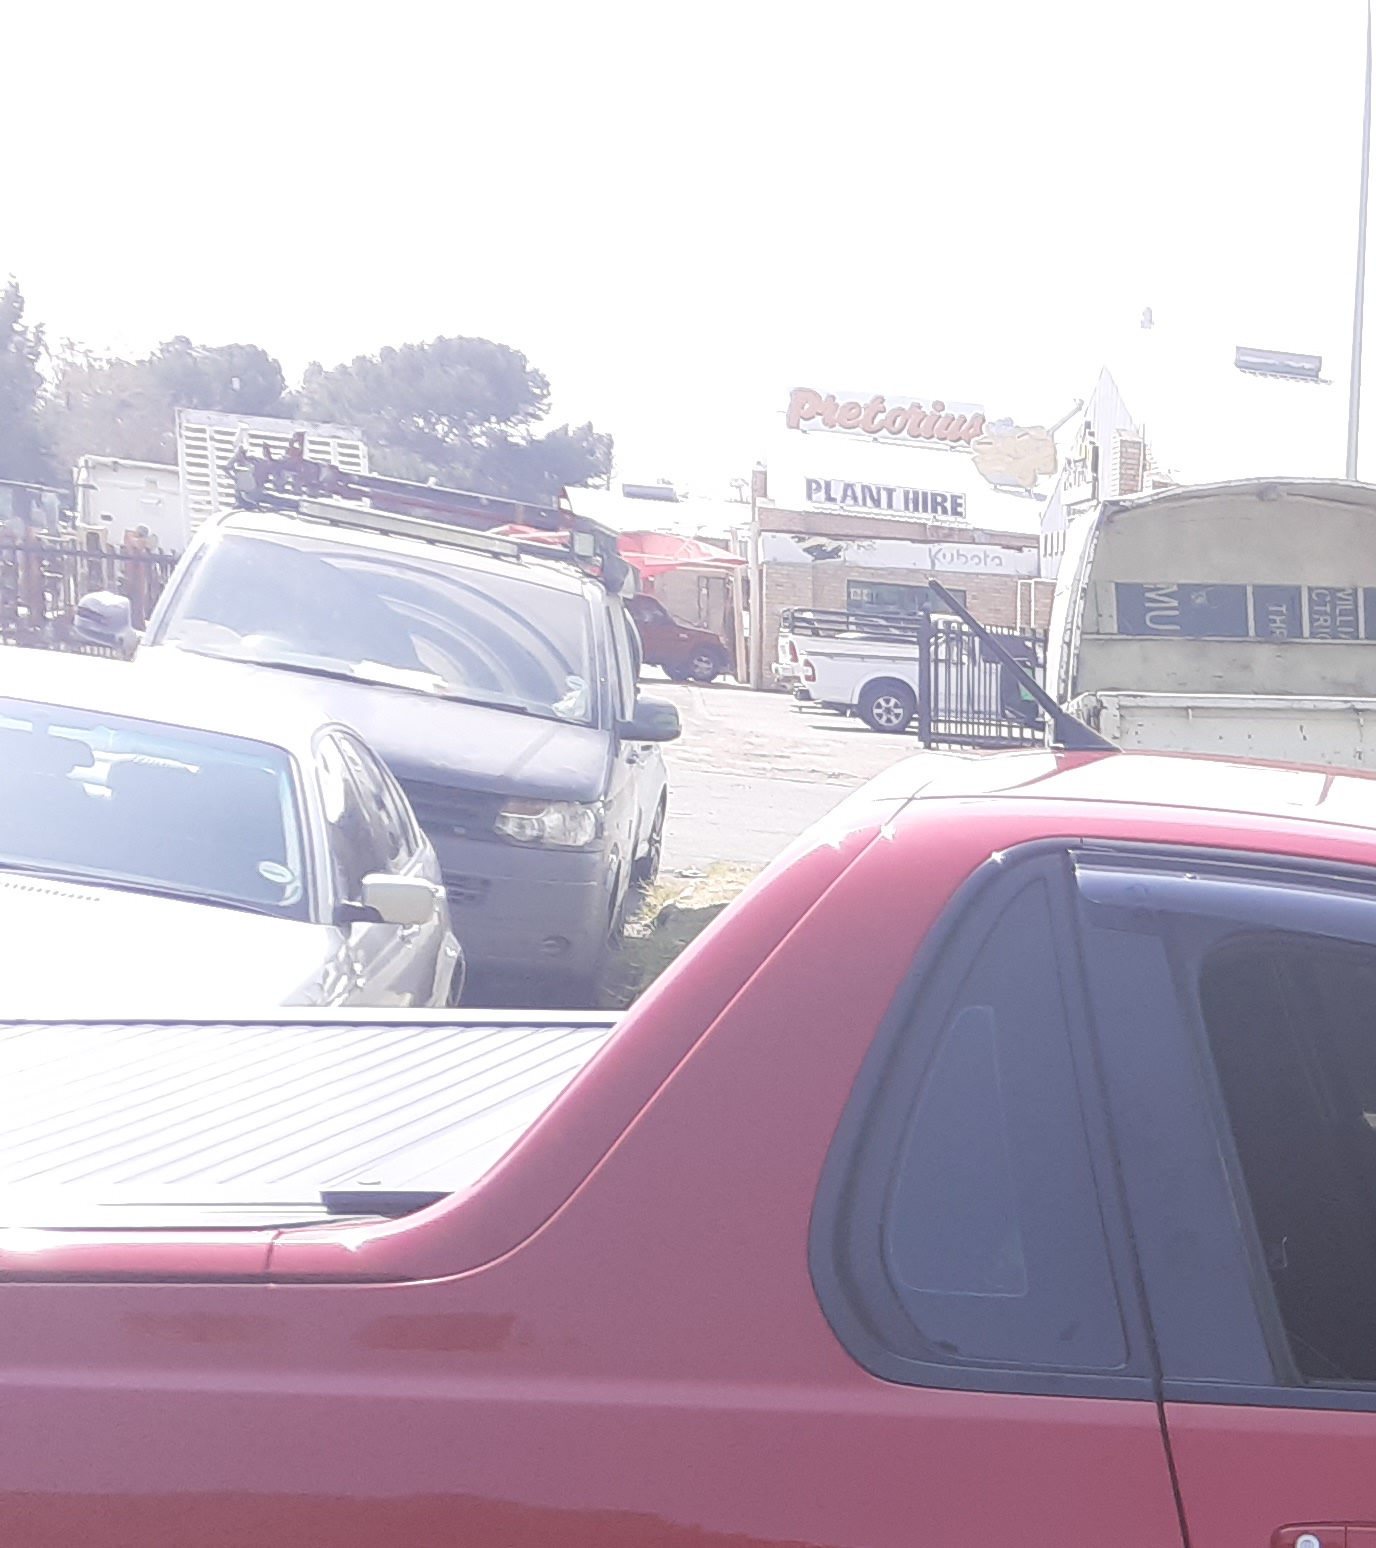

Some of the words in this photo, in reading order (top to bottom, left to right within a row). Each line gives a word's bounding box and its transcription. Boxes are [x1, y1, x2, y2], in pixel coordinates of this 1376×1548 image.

[786, 387, 986, 445] Pretorius
[805, 477, 897, 510] PLANT
[902, 488, 965, 517] HIRE
[928, 546, 1003, 569] Kubota
